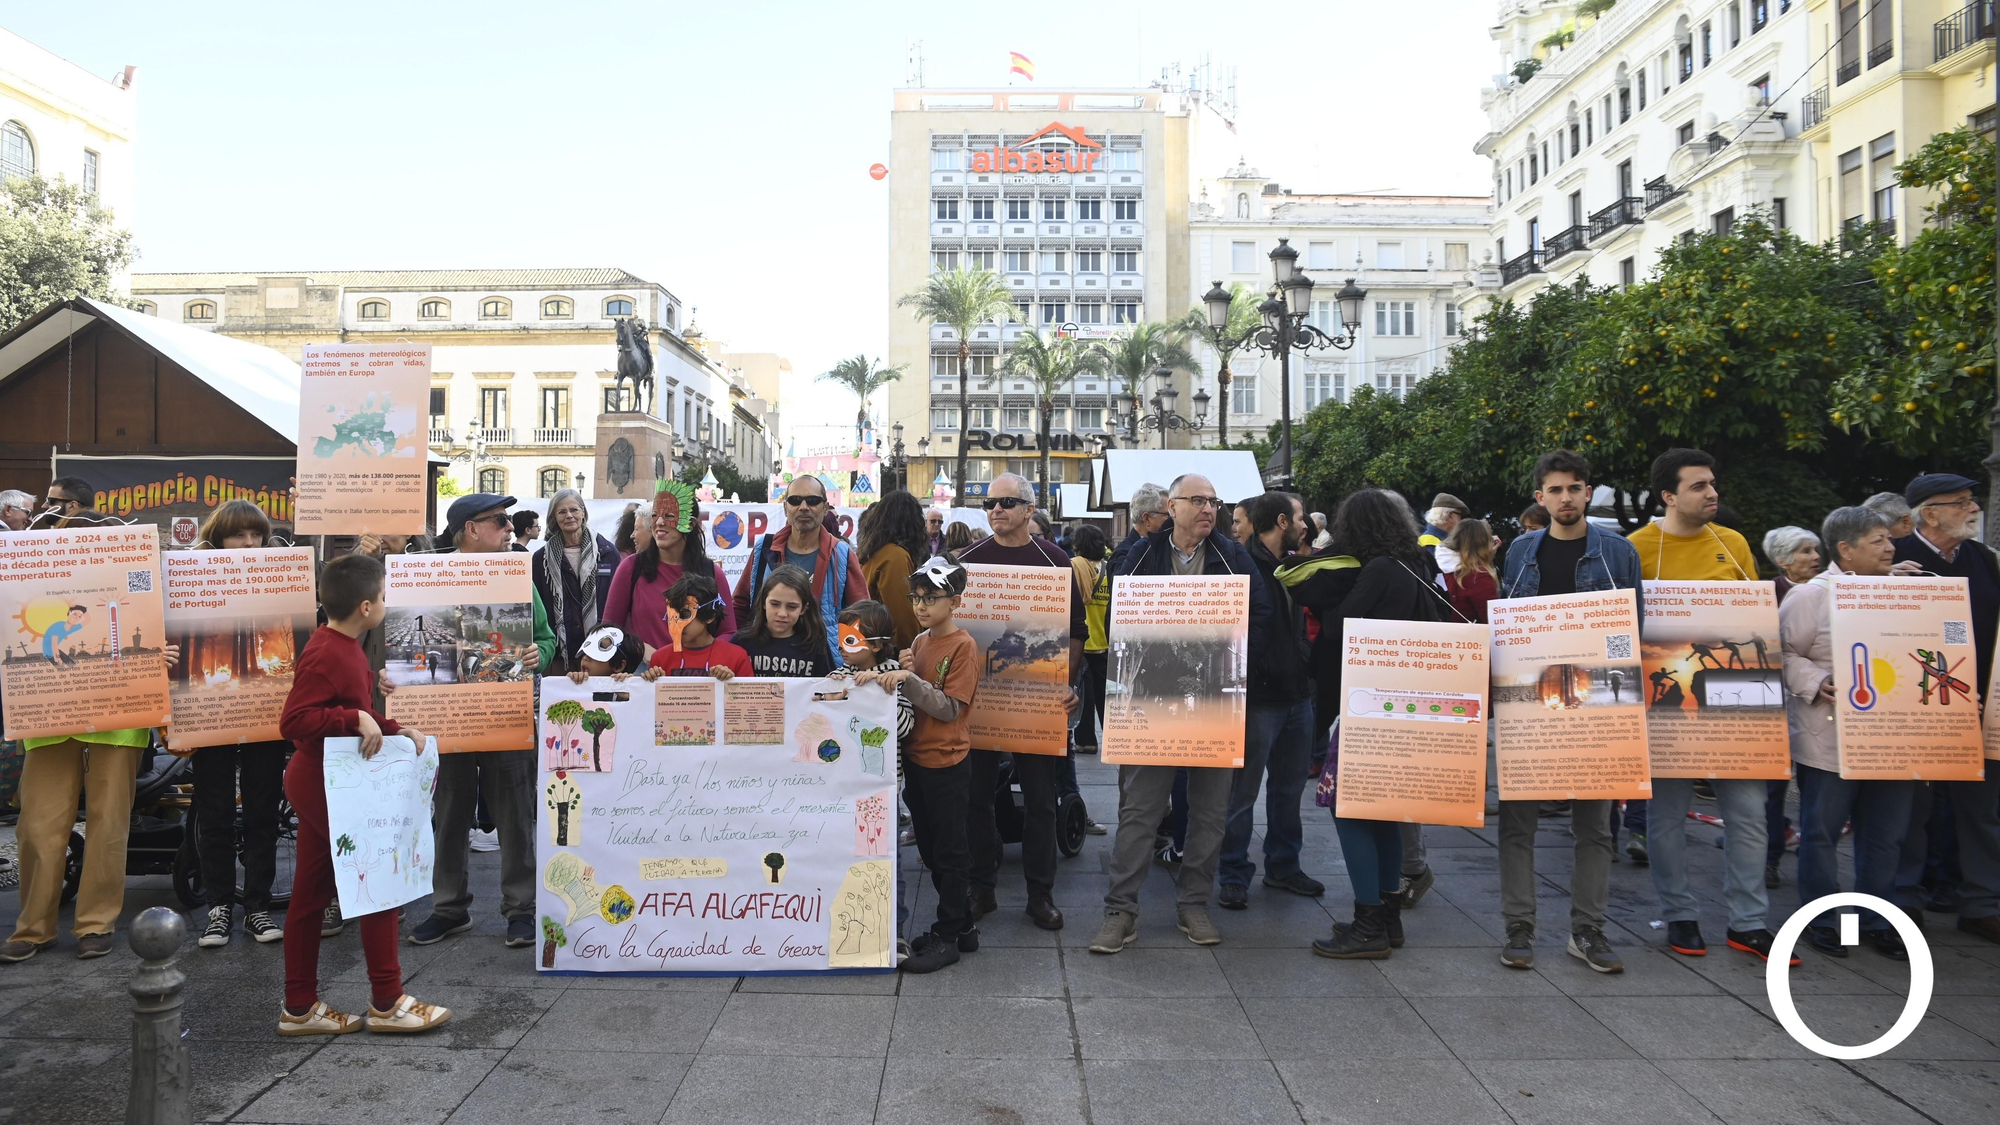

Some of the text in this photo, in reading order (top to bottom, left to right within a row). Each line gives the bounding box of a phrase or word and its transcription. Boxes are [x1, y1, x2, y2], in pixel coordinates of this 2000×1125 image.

[972, 146, 1100, 173] albasur
[1003, 175, 1070, 185] inmobiliarias
[323, 350, 364, 358] fenómenos
[369, 350, 426, 358] metereológicos
[349, 369, 375, 377] Europa
[175, 523, 194, 532] STOP
[12, 538, 50, 546] verano
[55, 536, 68, 544] de
[75, 534, 101, 543] 2024
[124, 534, 136, 542] ya
[69, 545, 90, 554] más
[94, 544, 136, 553] muertes
[139, 542, 152, 550] de
[168, 553, 308, 566] Desde 1980, los incendios
[448, 559, 479, 567] Cambio
[484, 558, 525, 566] Climático,
[0, 570, 71, 581] temperaturas
[168, 579, 203, 588] Europa
[245, 575, 284, 584] 190.000
[251, 586, 260, 594] la
[264, 584, 309, 594] superficie
[415, 579, 487, 587] económicamente
[1168, 581, 1206, 589] Municipal
[1223, 581, 1243, 589] jacta
[1836, 582, 1870, 591] Replican
[1882, 583, 1938, 591] Ayuntamiento
[1654, 586, 1697, 594] JUSTICIA
[1699, 587, 1752, 595] AMBIENTAL
[184, 598, 225, 608] Portugal
[998, 592, 1030, 600] Acuerdo
[1045, 594, 1065, 602] París
[1493, 606, 1506, 614] Sin
[1509, 603, 1547, 613] medidas
[1549, 599, 1600, 610] adecuadas
[415, 614, 425, 632] 1
[1494, 620, 1631, 637] podría sufrir clima extremo
[487, 631, 504, 655] 3
[1359, 636, 1383, 645] clima
[1400, 638, 1438, 647] Córdoba
[1455, 641, 1481, 649] 2100:
[1508, 636, 1531, 645] 2050
[1348, 646, 1360, 654] 79
[1367, 648, 1399, 656] noches
[1406, 650, 1451, 659] tropicales
[1471, 652, 1483, 660] 61
[413, 653, 428, 671] 2
[726, 775, 763, 790] niños
[759, 778, 778, 806] y
[782, 774, 826, 786] niñas
[591, 806, 606, 816] no
[610, 806, 646, 816] somos
[649, 799, 665, 815] el
[723, 805, 764, 815] somos
[771, 797, 790, 814] el
[663, 832, 672, 843] a
[678, 823, 693, 842] la
[700, 821, 784, 843] Naturaleza
[642, 858, 708, 870] TENEMOS QUE
[638, 892, 695, 917] AFA
[573, 926, 611, 959] Con
[618, 923, 641, 958] la
[742, 935, 766, 956] de
